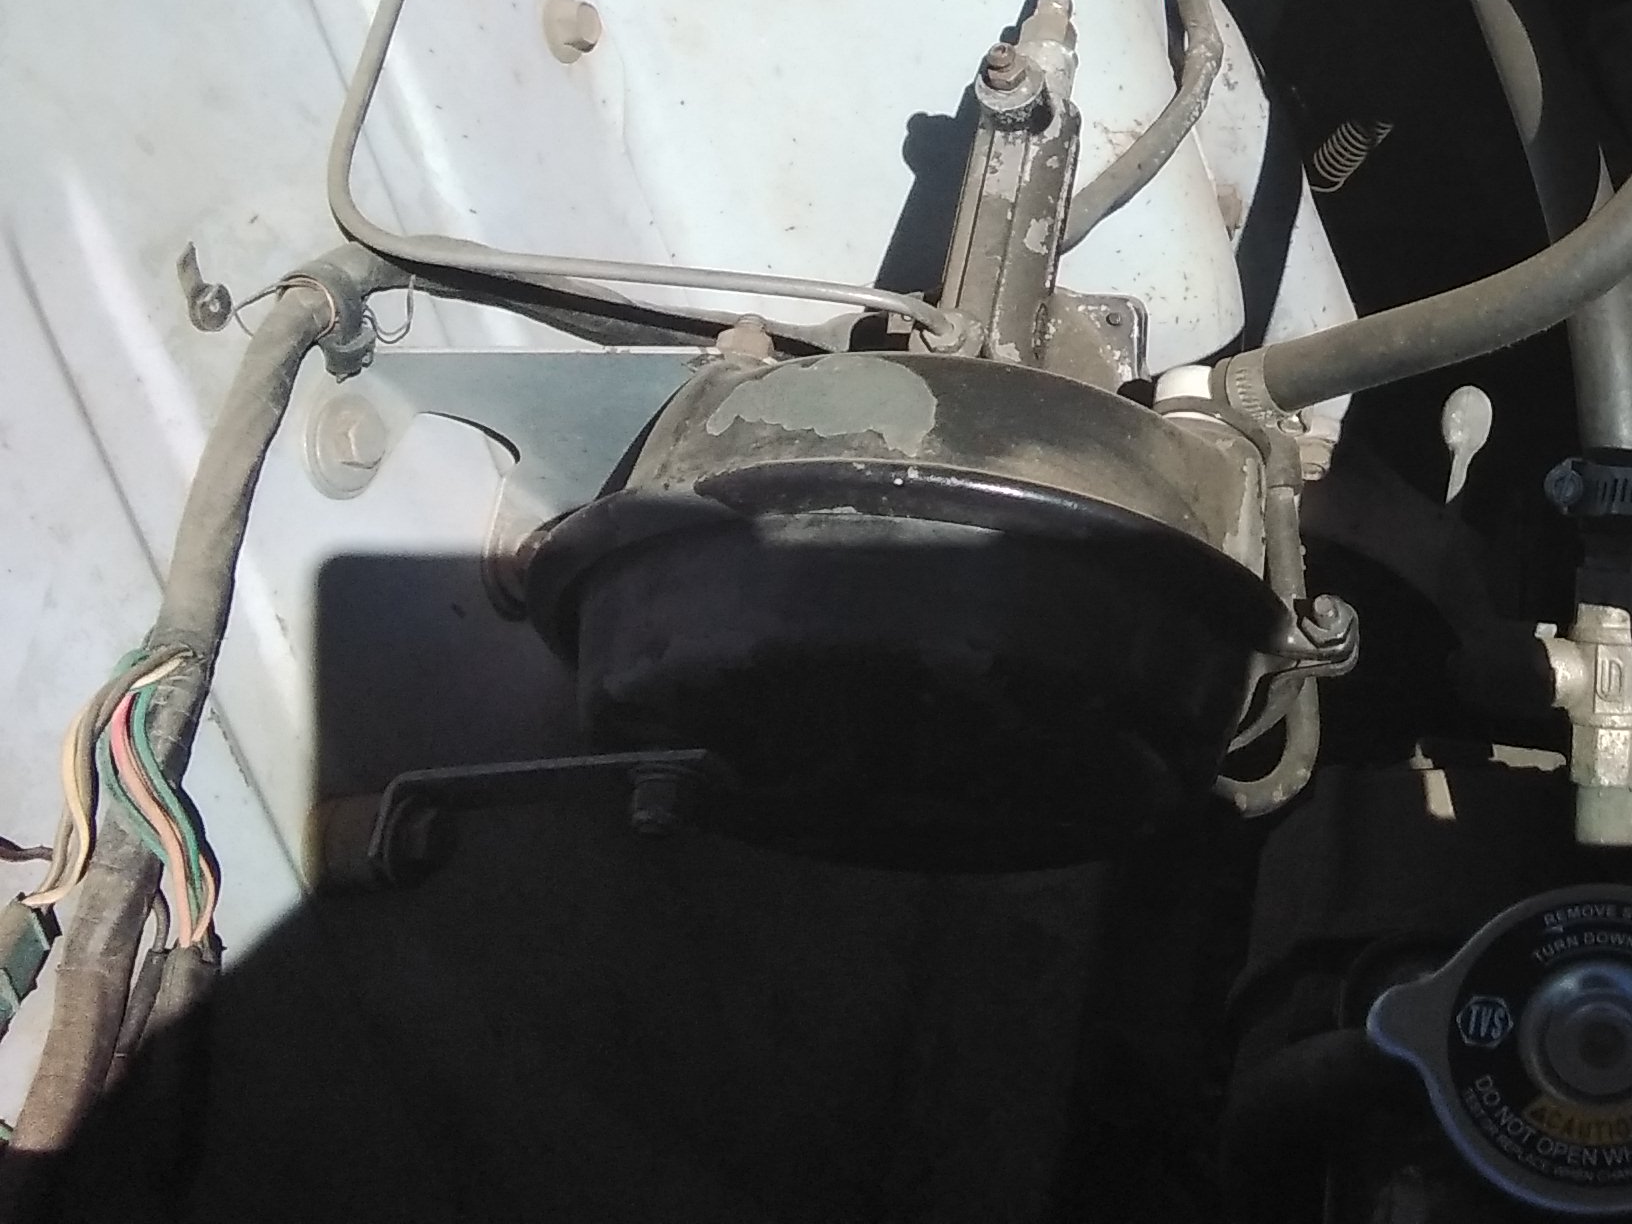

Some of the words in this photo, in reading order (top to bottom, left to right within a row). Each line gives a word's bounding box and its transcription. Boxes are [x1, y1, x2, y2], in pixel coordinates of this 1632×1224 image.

[1543, 903, 1617, 927] REMOVE
[1532, 936, 1579, 964] TURN
[1469, 1005, 1506, 1040] TVS
[1475, 1074, 1501, 1107] DO
[1493, 1104, 1537, 1144] NOT
[1536, 1138, 1598, 1167] OPEN
